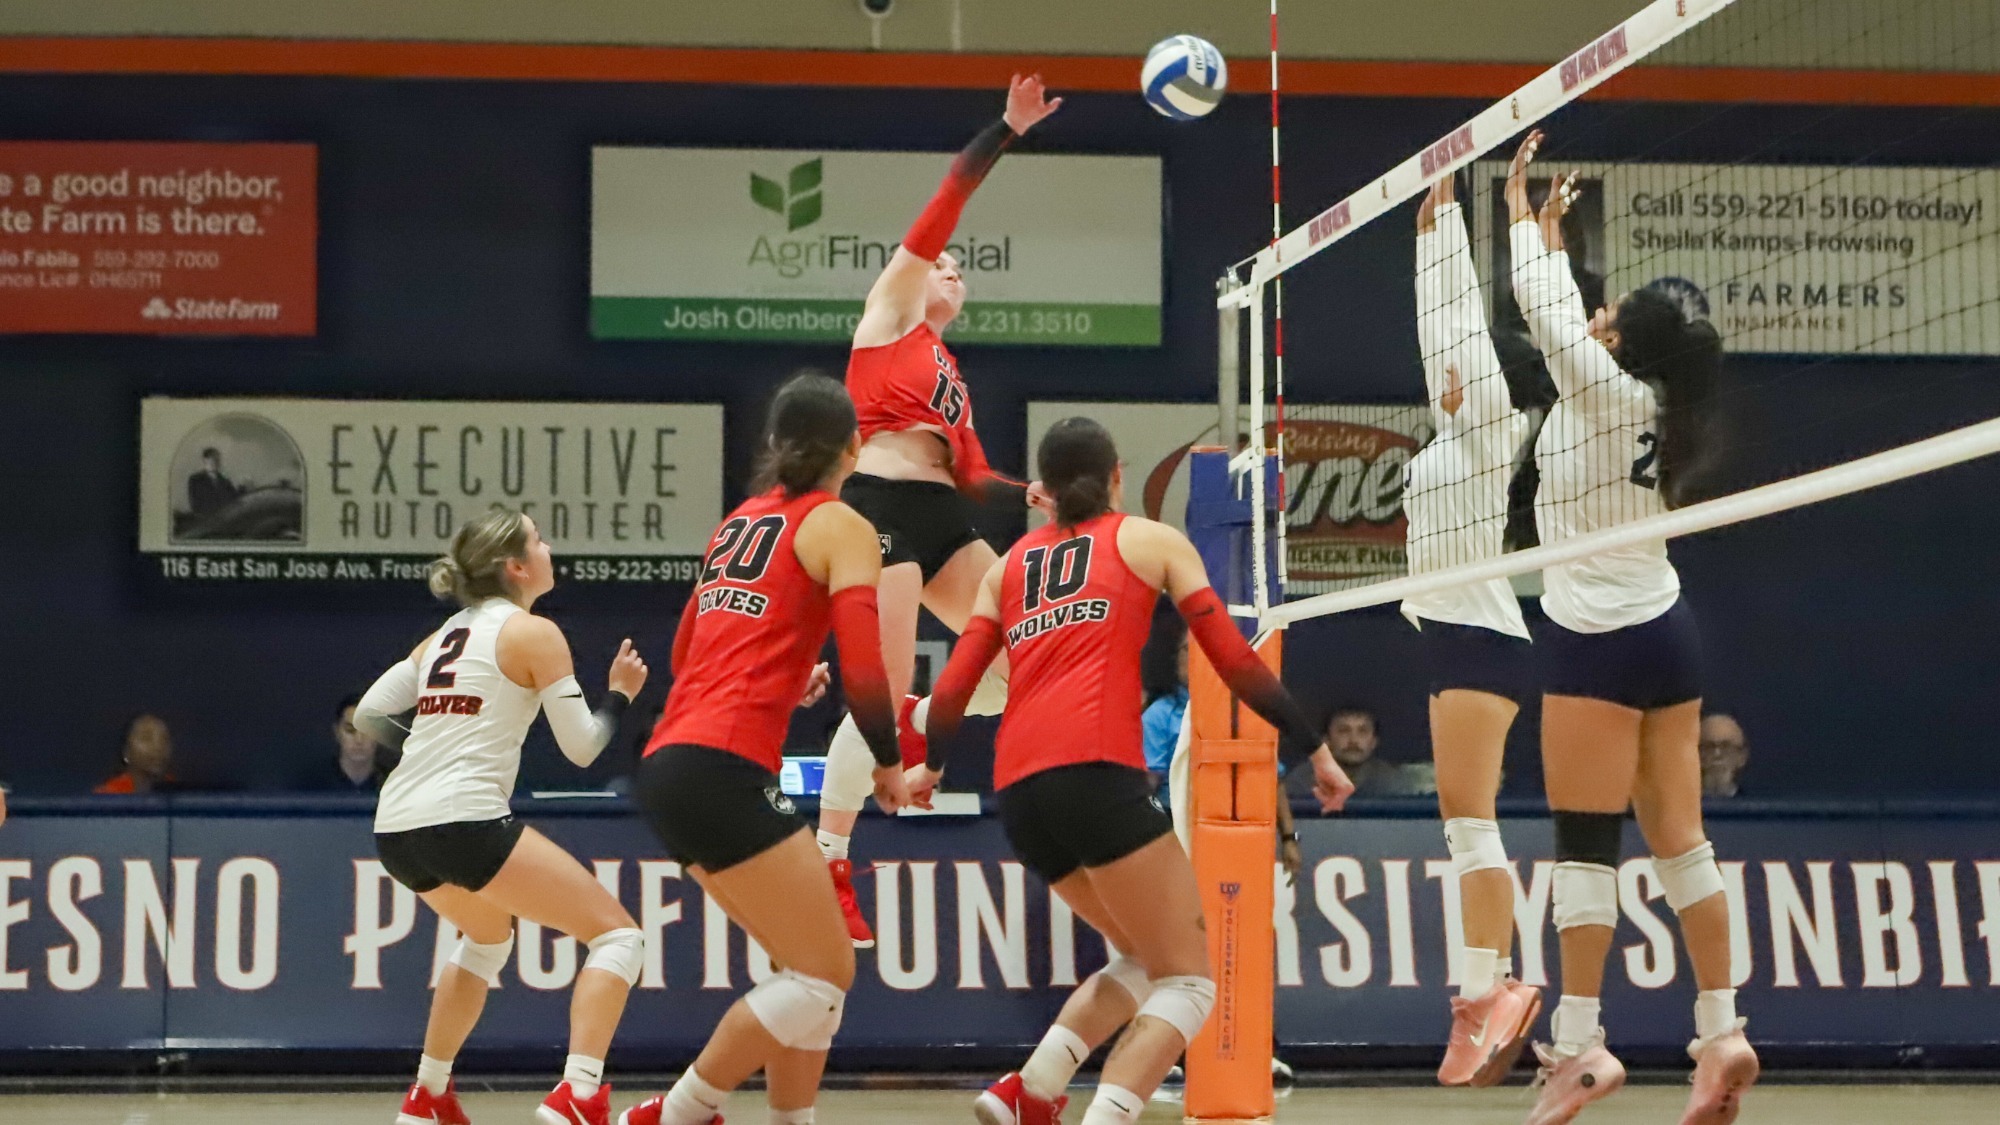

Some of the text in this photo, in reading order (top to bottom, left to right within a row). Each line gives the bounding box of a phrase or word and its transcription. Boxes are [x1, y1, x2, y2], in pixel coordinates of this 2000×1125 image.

[24, 174, 41, 197] a
[52, 168, 129, 202] good
[139, 169, 282, 205] neighbor,
[42, 204, 127, 234] Farm
[137, 205, 162, 234] is
[171, 205, 265, 235] there.
[1631, 192, 1983, 228] Call 559-221-5160 today!
[1631, 228, 1704, 250] Sheila
[1726, 282, 1906, 308] FARMERS
[663, 307, 730, 330] Josh
[945, 309, 1091, 334] 9.231.3510
[1726, 316, 1847, 332] INSURANCE
[928, 369, 965, 428] 15
[1283, 427, 1379, 456] Raising
[327, 424, 677, 498] EXECUTIVE
[1629, 431, 1658, 490] 2
[339, 501, 666, 541] AUTO NTER
[700, 514, 788, 589] 20
[1356, 547, 1410, 564] FING
[160, 557, 190, 578] 116
[196, 558, 238, 578] East
[243, 559, 279, 578] San
[284, 559, 328, 579] Jose
[333, 560, 375, 579] Ave.
[573, 560, 700, 581] 559-222-9191
[1022, 534, 1094, 614] 10
[698, 587, 770, 619] OLVES
[1007, 599, 1110, 650] WOLVES
[426, 627, 472, 690] 2
[417, 694, 484, 717] OLVES
